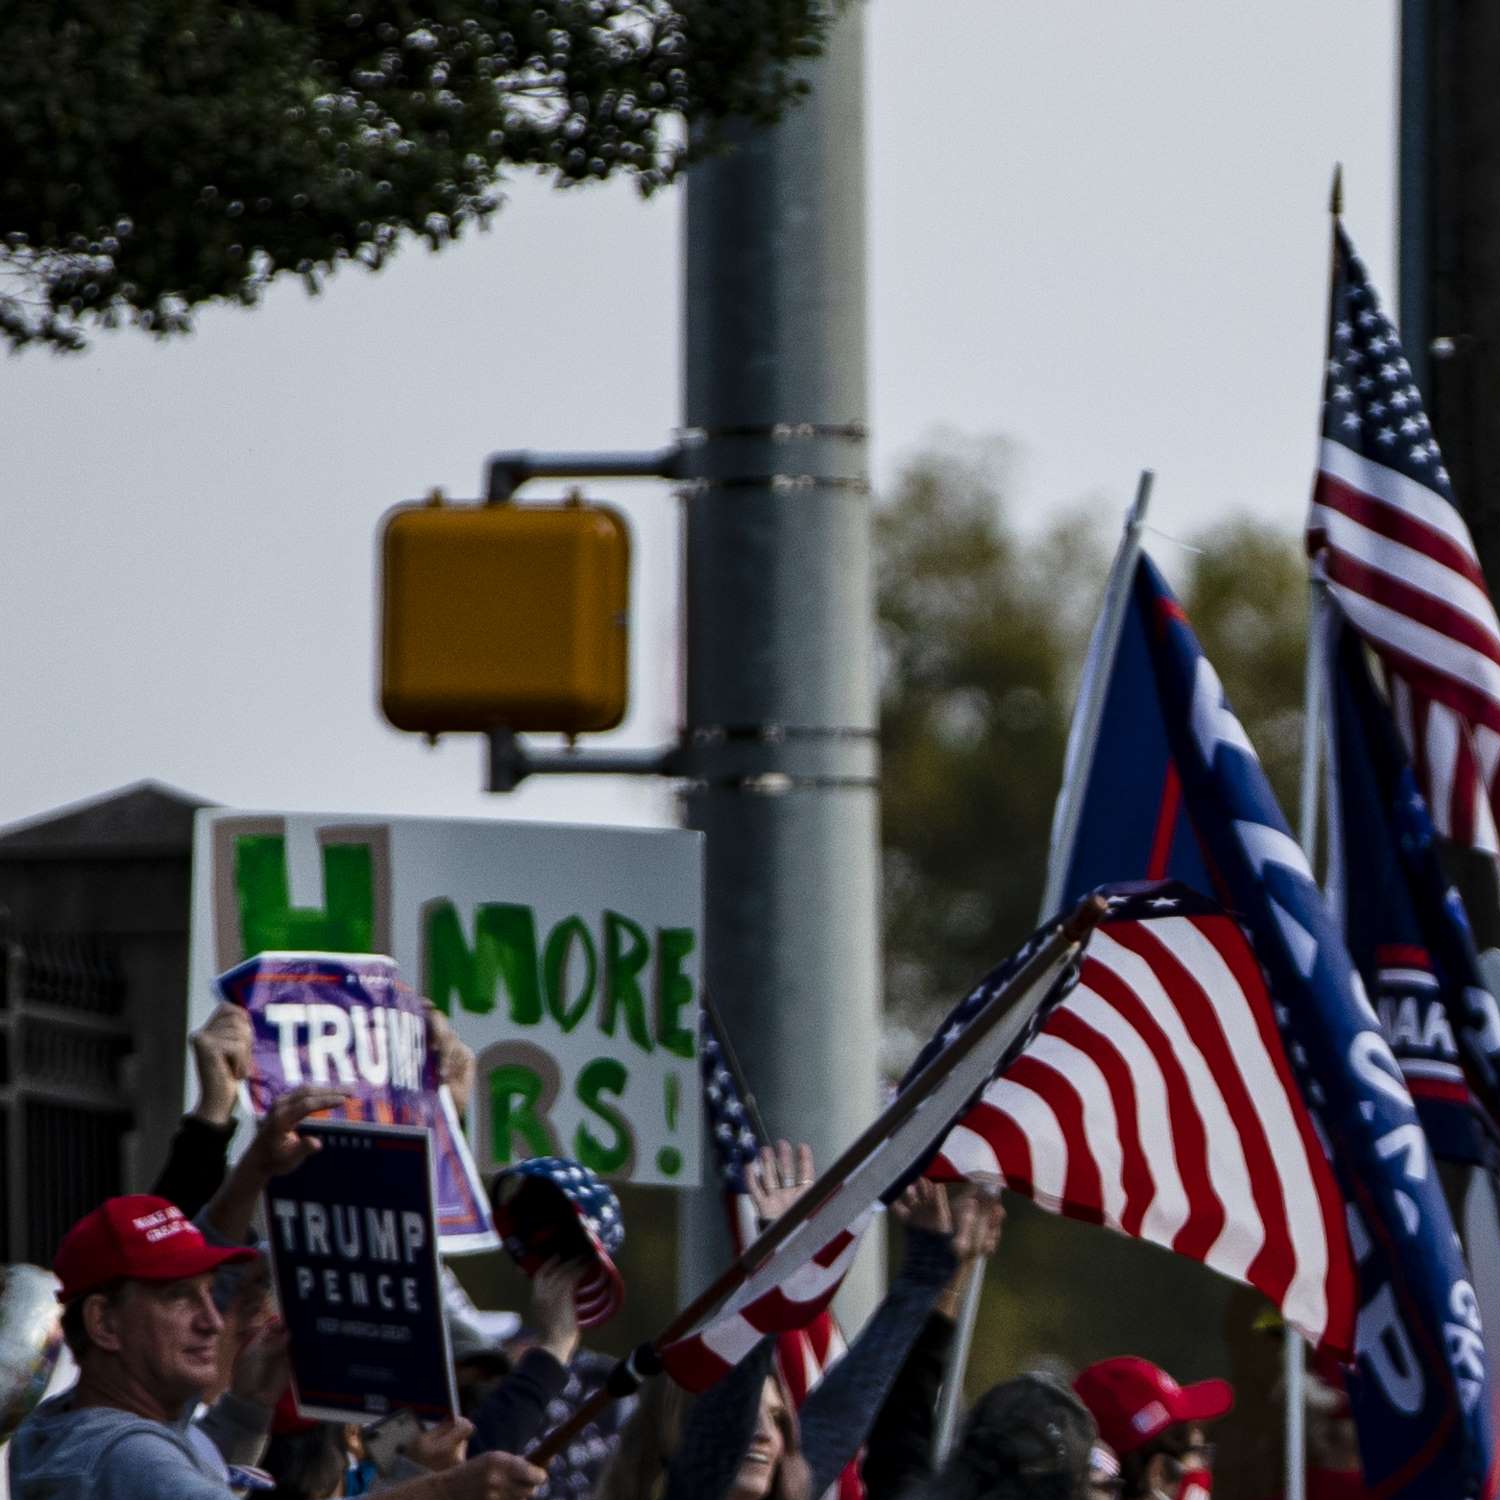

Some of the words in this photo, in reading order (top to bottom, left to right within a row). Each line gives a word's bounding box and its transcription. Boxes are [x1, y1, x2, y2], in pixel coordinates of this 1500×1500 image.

[418, 896, 697, 1060] MORE
[274, 1198, 426, 1264] TRUMP
[296, 1266, 421, 1313] PENCE
